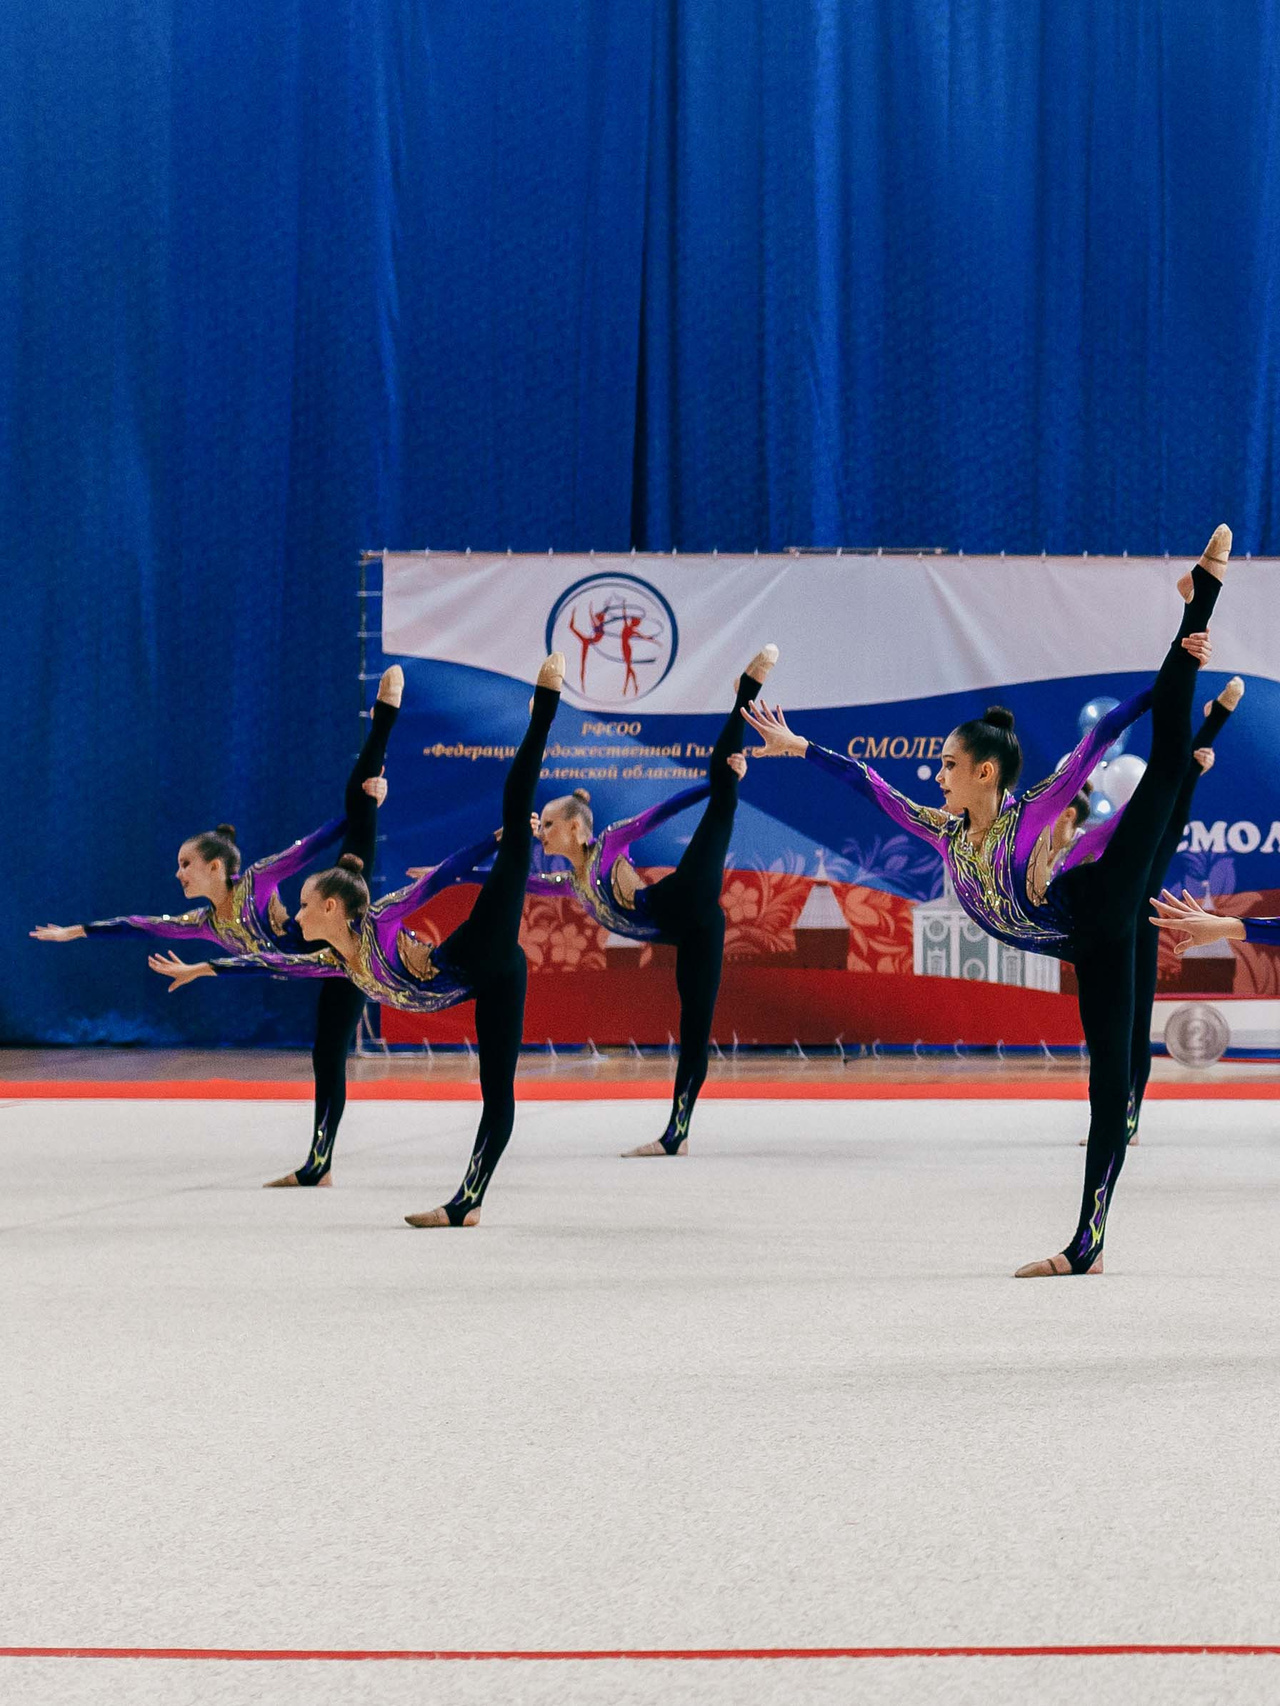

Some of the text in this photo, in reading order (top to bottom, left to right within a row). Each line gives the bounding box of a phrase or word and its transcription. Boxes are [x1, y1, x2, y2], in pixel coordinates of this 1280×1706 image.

[581, 721, 642, 737] РФСОО
[422, 743, 519, 761] «Федераци
[847, 736, 945, 759] СМОЛЕ
[540, 764, 618, 780] оленской
